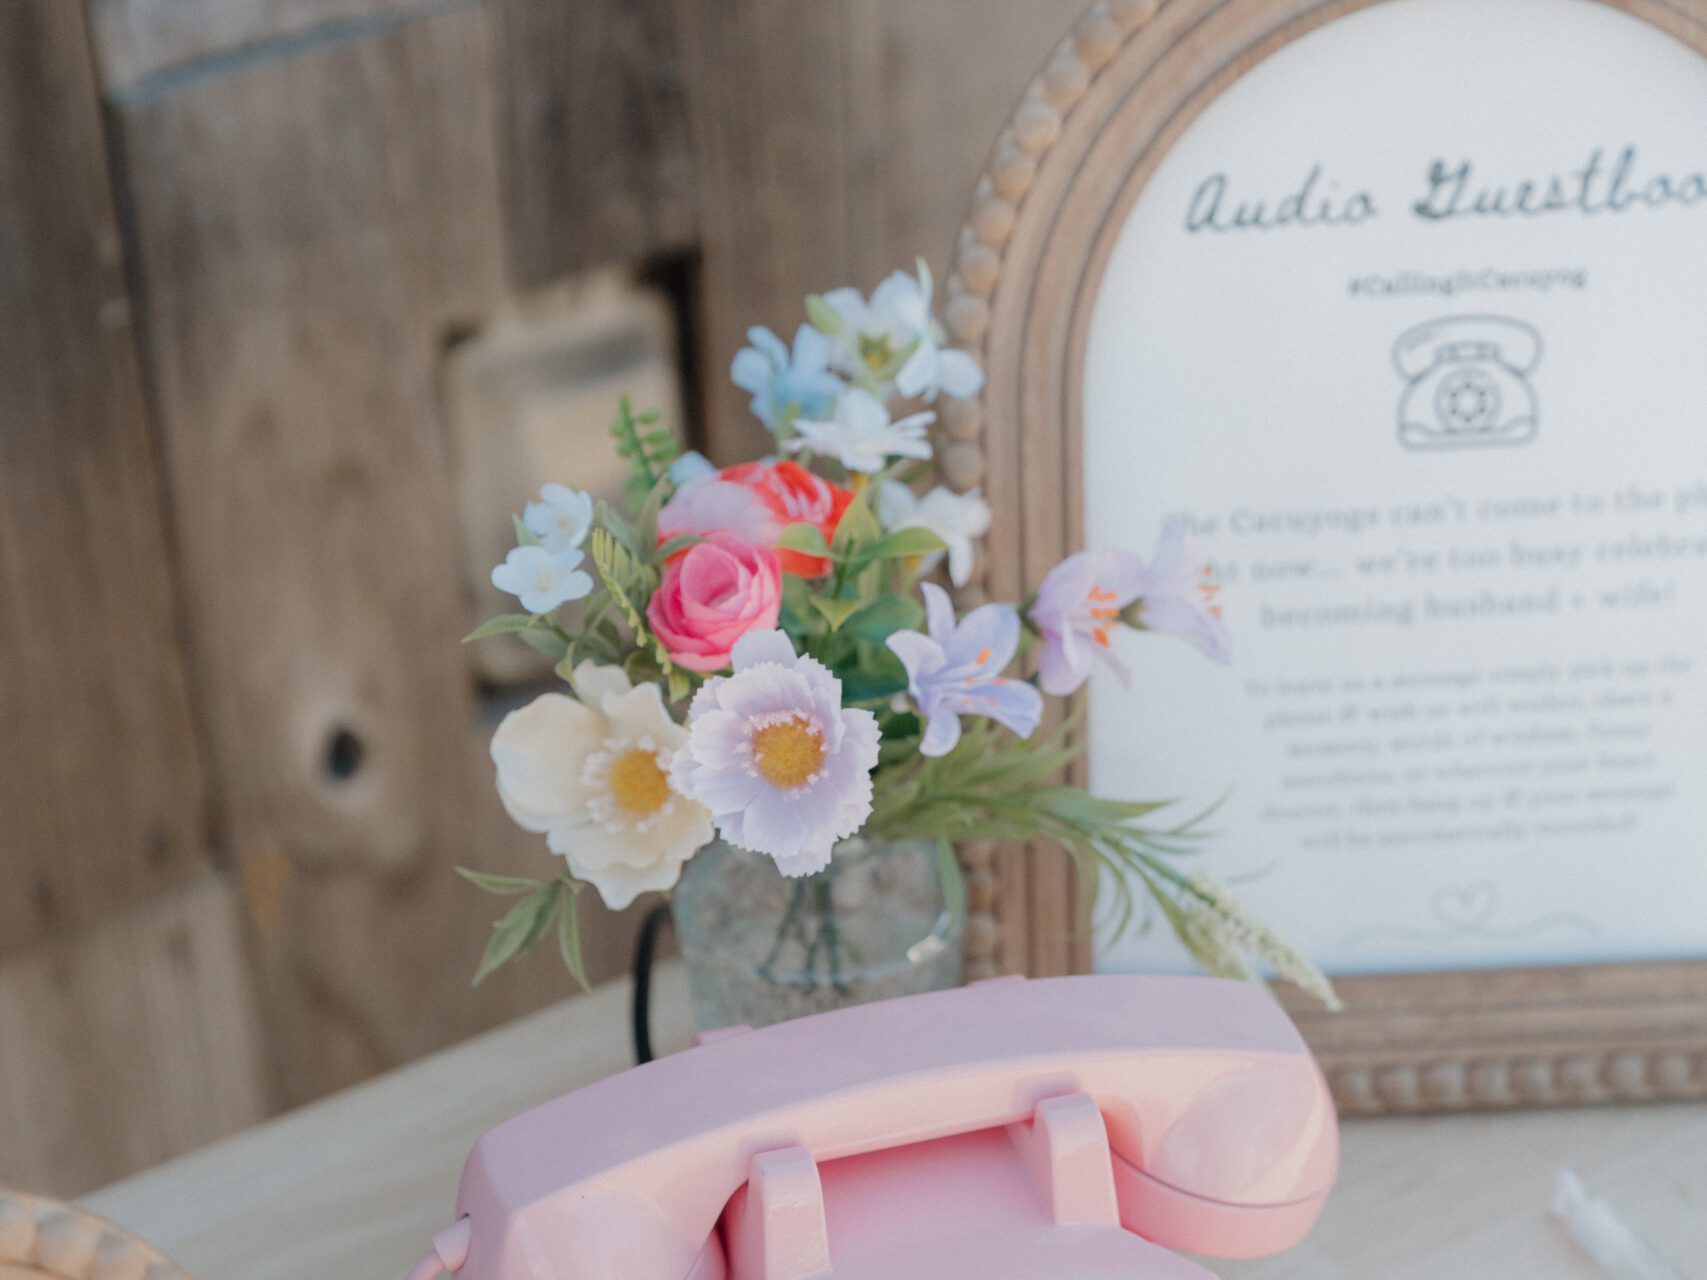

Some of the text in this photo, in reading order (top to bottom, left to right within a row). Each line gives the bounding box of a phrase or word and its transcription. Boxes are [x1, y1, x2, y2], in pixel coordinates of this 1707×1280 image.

[1185, 161, 1377, 234] Audio
[1611, 484, 1666, 513] the
[1425, 585, 1559, 618] husband
